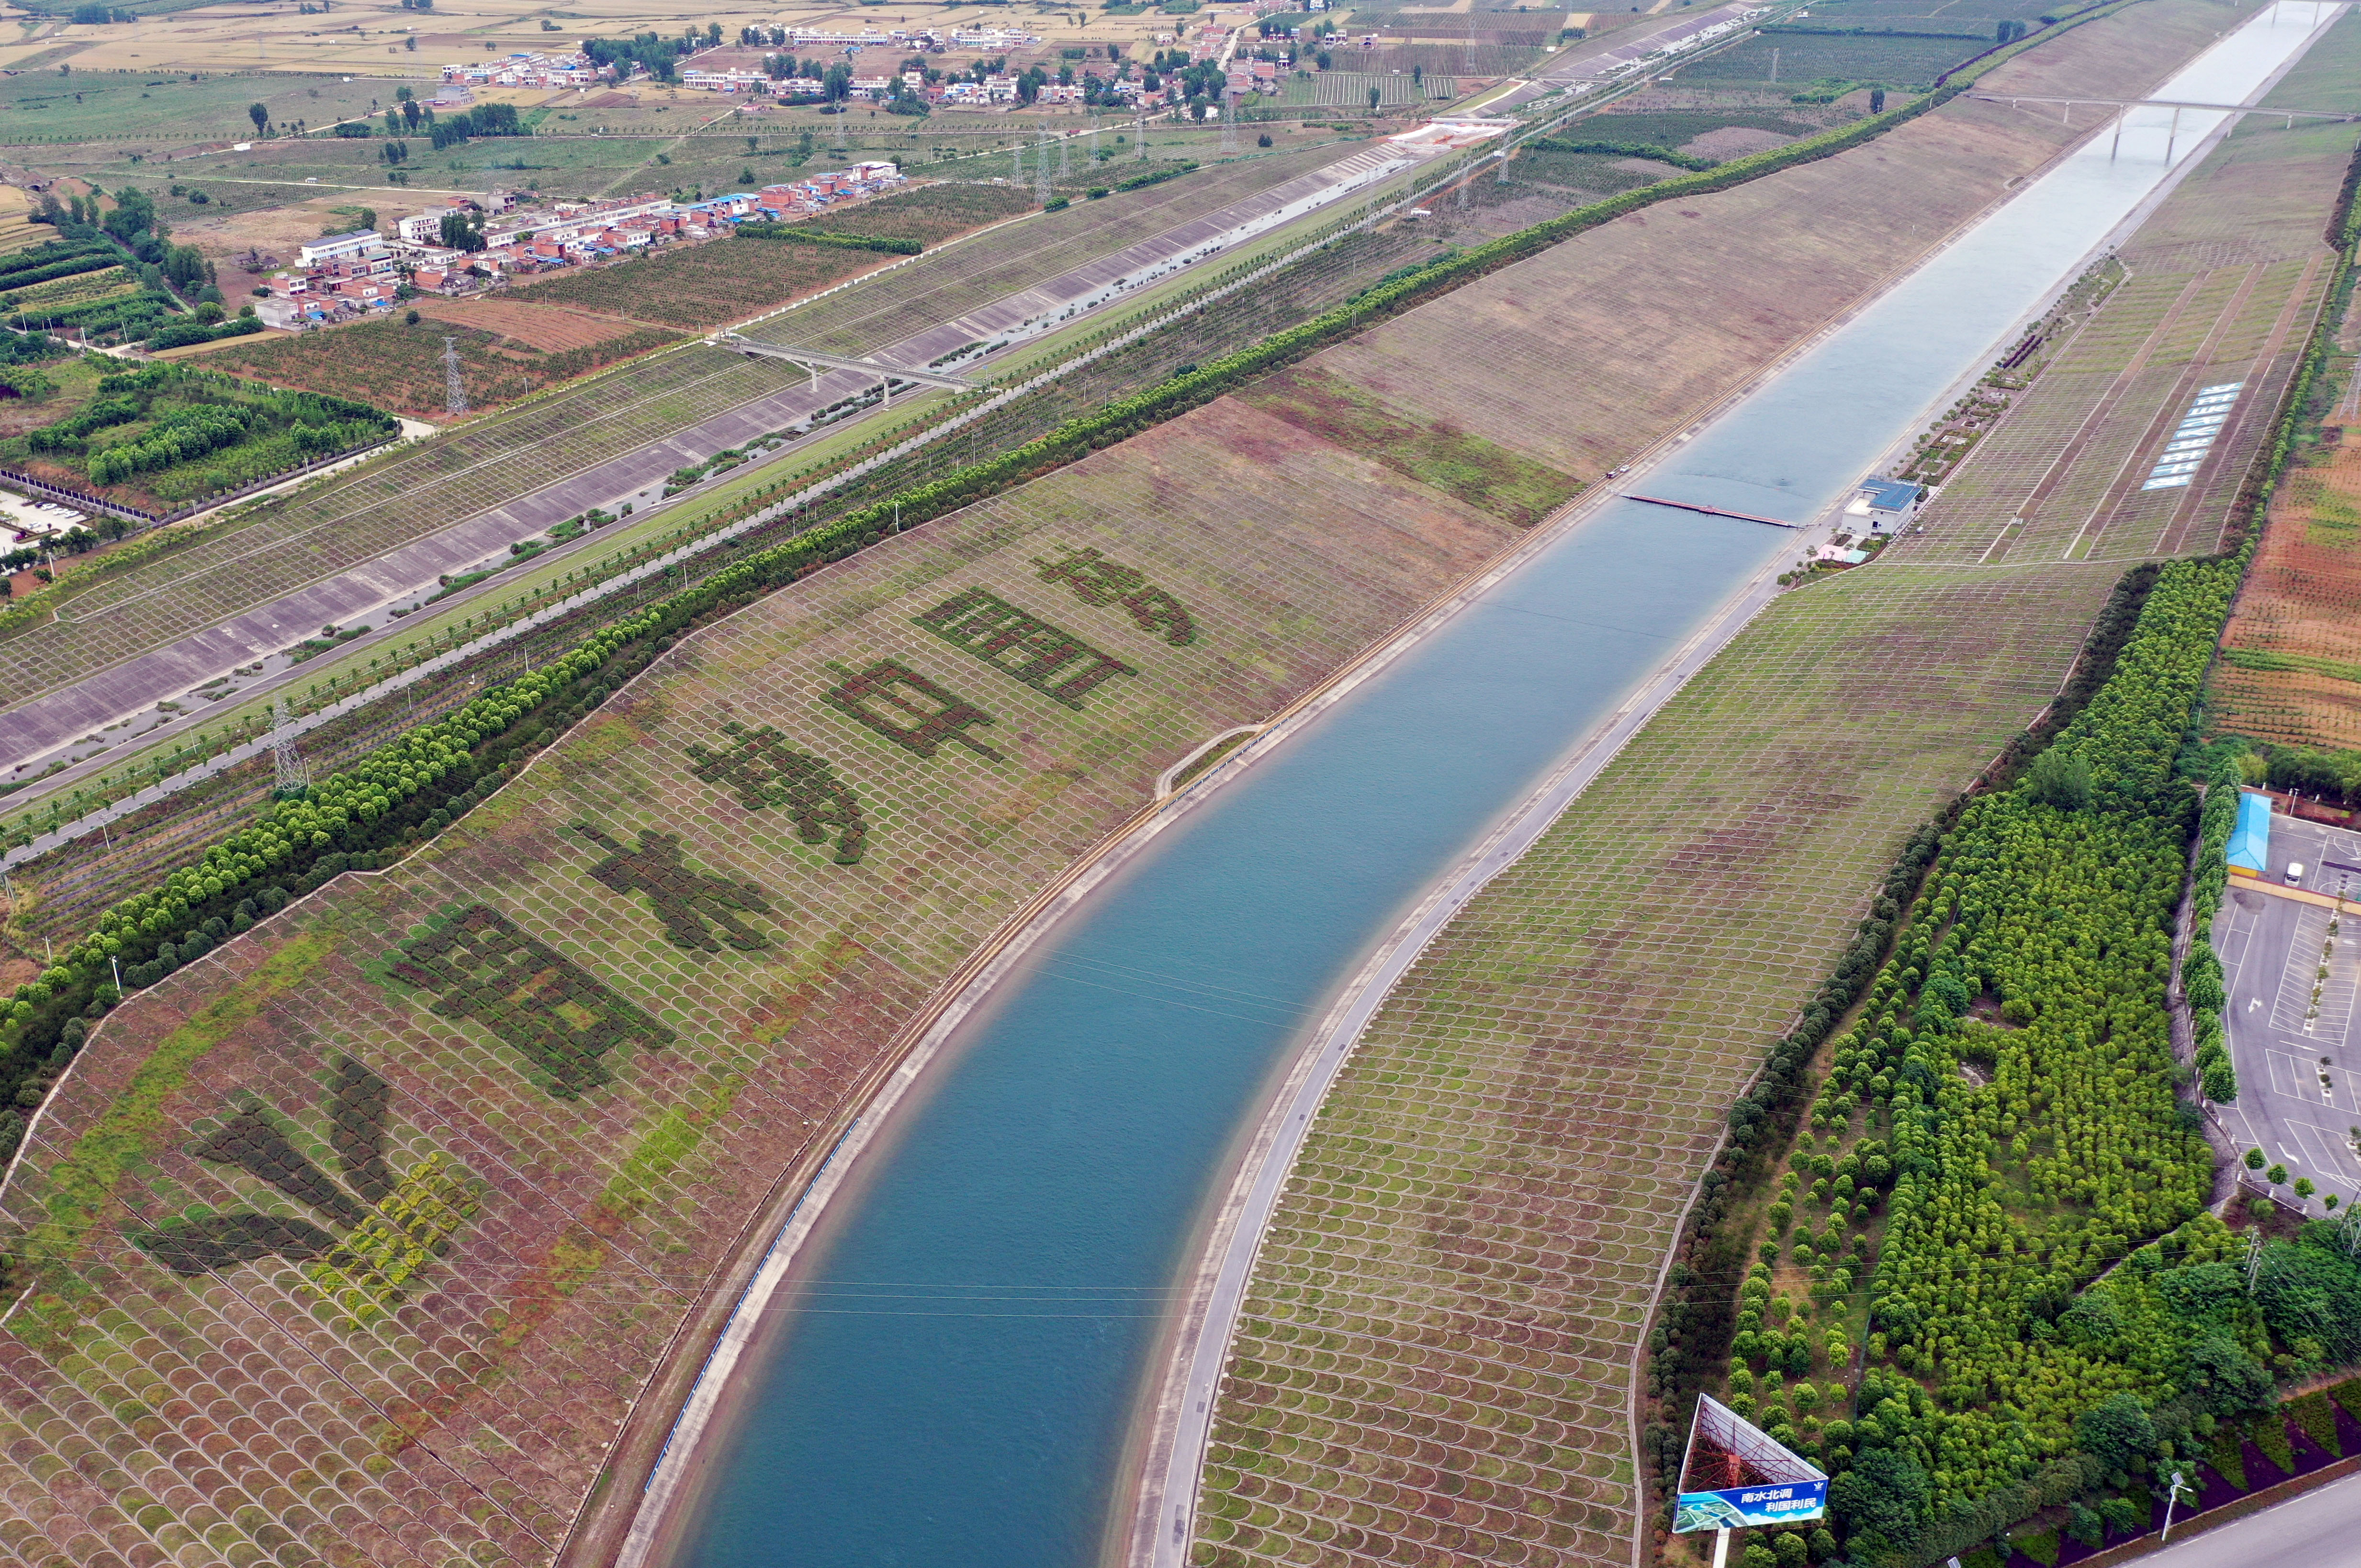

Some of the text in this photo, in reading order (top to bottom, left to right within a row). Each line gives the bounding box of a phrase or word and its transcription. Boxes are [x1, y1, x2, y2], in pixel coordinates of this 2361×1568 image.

[2146, 383, 2238, 489] 功在当代 利在千秋
[1741, 1488, 1793, 1503] 南水北调
[1765, 1498, 1817, 1512] 利国利民
